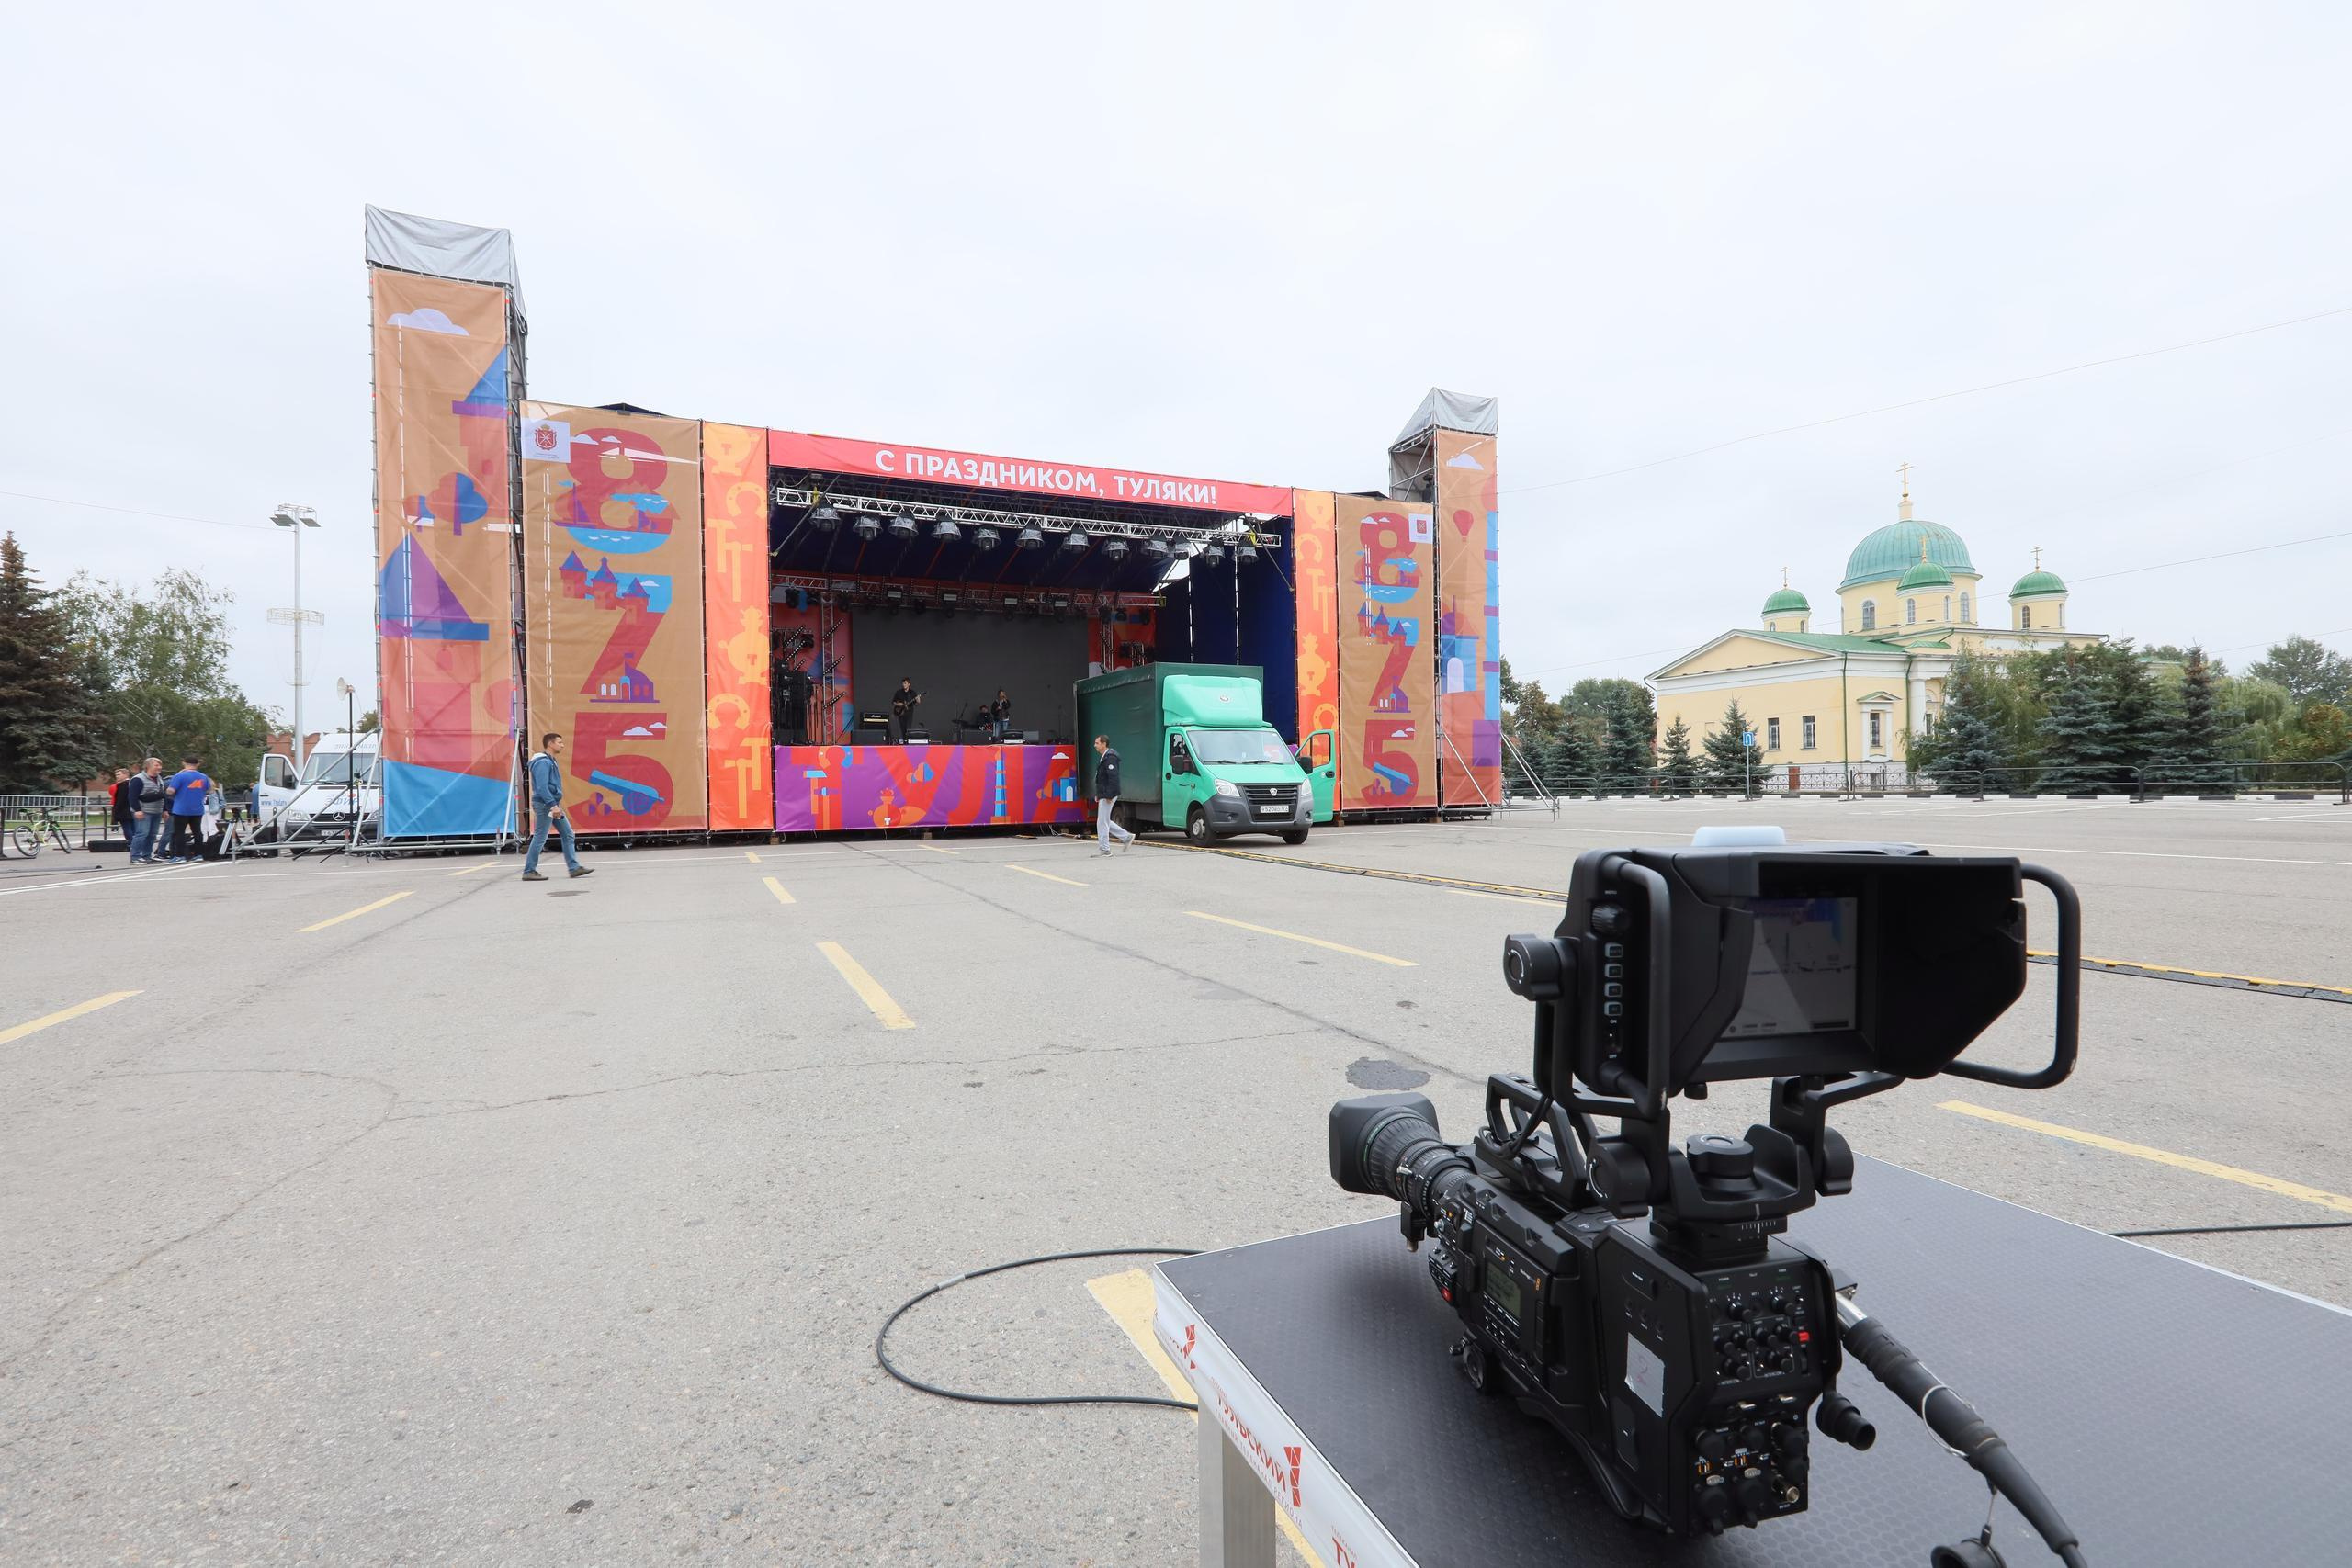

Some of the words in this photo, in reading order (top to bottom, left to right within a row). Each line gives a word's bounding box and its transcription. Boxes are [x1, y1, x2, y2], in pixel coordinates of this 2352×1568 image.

[875, 449, 895, 472] С
[904, 453, 1104, 497] ПРАЗДНИКОМ,
[1113, 475, 1217, 505] ТУЛЯКИ!
[1273, 1485, 1303, 1530] РЕГИОНА
